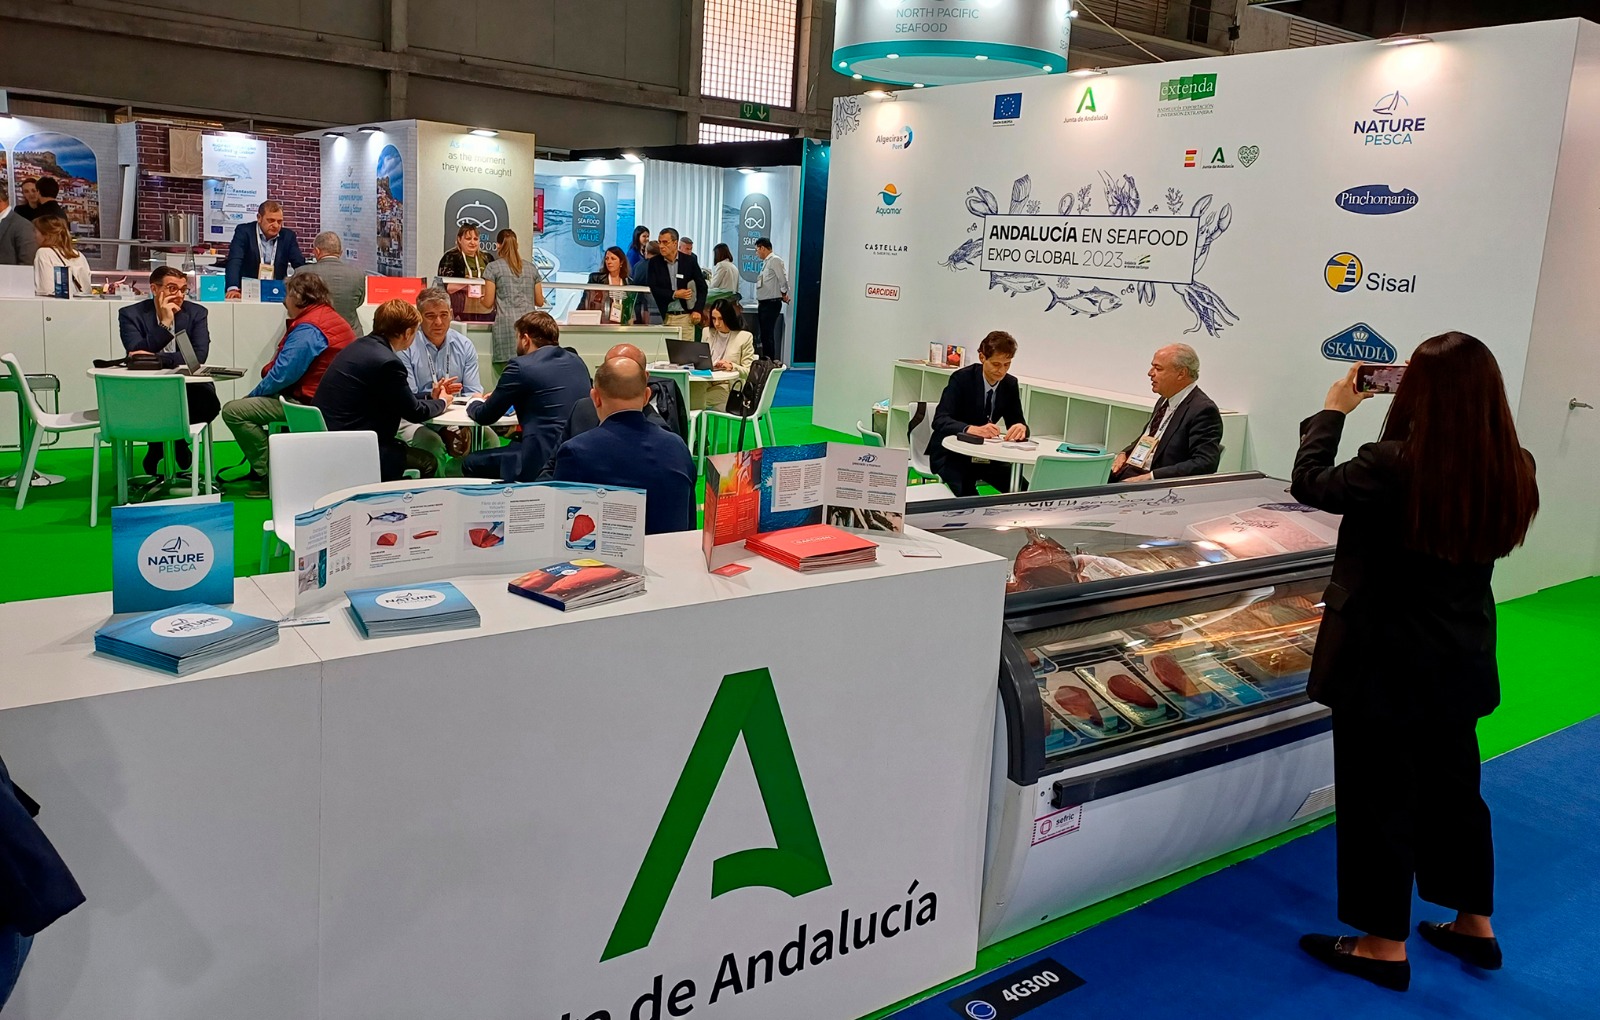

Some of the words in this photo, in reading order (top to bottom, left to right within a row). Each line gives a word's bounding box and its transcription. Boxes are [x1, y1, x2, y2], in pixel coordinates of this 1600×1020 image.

[896, 8, 934, 19] NORTH
[937, 9, 980, 19] PACIFIC
[895, 23, 948, 33] SEAFOOD
[1161, 77, 1214, 96] extenda
[1084, 113, 1109, 121] Andalucía
[1354, 117, 1426, 134] NATURE
[876, 135, 903, 145] Algeciras
[1364, 133, 1413, 146] PESCA
[448, 152, 458, 160] as
[459, 153, 472, 161] the
[474, 155, 506, 165] moment
[442, 162, 459, 173] they
[461, 165, 483, 174] were
[484, 167, 512, 177] caught!
[1340, 192, 1416, 206] Pinchomania
[876, 206, 902, 216] Aquamar
[577, 233, 600, 241] VALUE
[989, 222, 1078, 242] ANDALUCÍA
[1082, 229, 1103, 243] EN
[1106, 228, 1189, 246] SEAFOOD
[743, 237, 752, 245] SEA
[865, 243, 908, 252] CASTELLAR
[988, 248, 1021, 262] EXPO
[1025, 250, 1079, 265] GLOBAL
[1082, 250, 1124, 268] 2023
[1366, 273, 1416, 293] Sisal
[867, 287, 898, 297] GARCIDEN
[1326, 341, 1390, 362] SKANDIA
[148, 552, 205, 566] NATURE
[158, 563, 197, 574] PESCA
[1055, 813, 1075, 826] sefric
[629, 974, 697, 1020] de
[708, 878, 938, 1006] Andalucía
[1001, 970, 1060, 1003] 4G300
